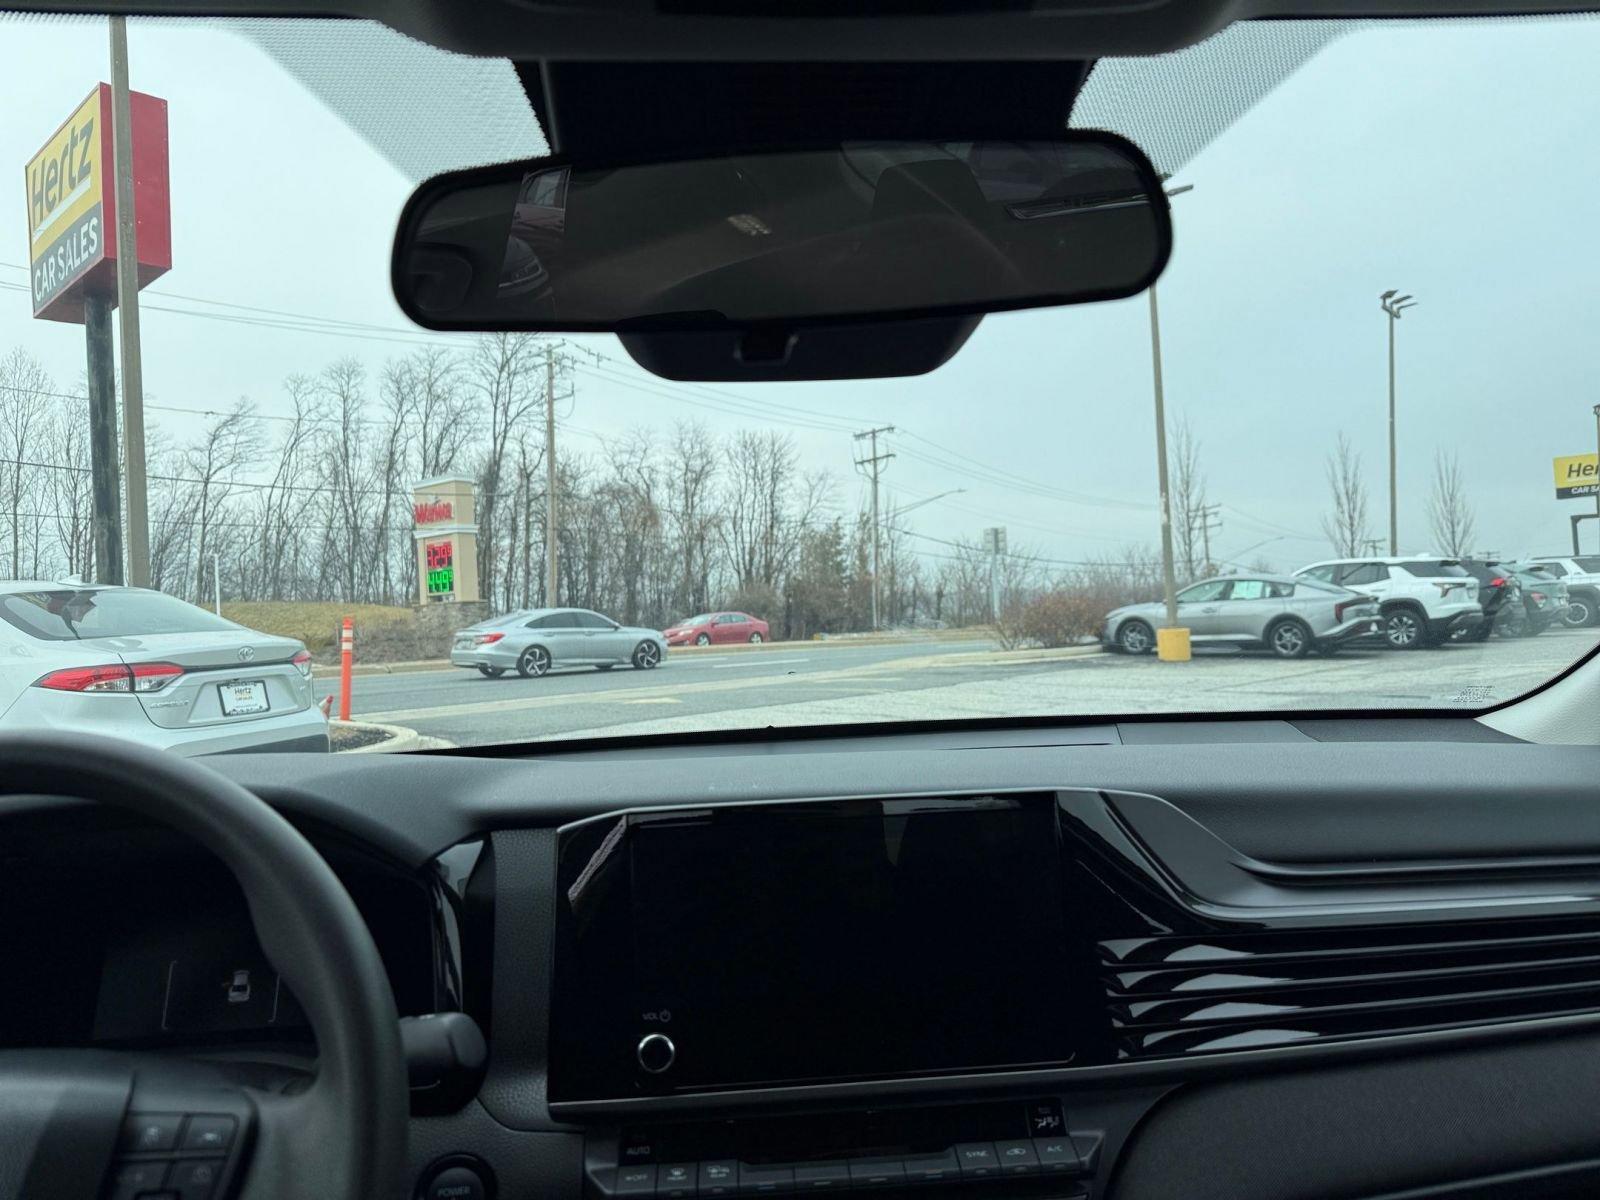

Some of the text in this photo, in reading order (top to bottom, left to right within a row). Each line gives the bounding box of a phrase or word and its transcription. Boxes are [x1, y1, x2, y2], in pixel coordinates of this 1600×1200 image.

[32, 117, 94, 226] Hertz
[34, 216, 98, 302] CAR SALES
[234, 687, 252, 695] Hertz
